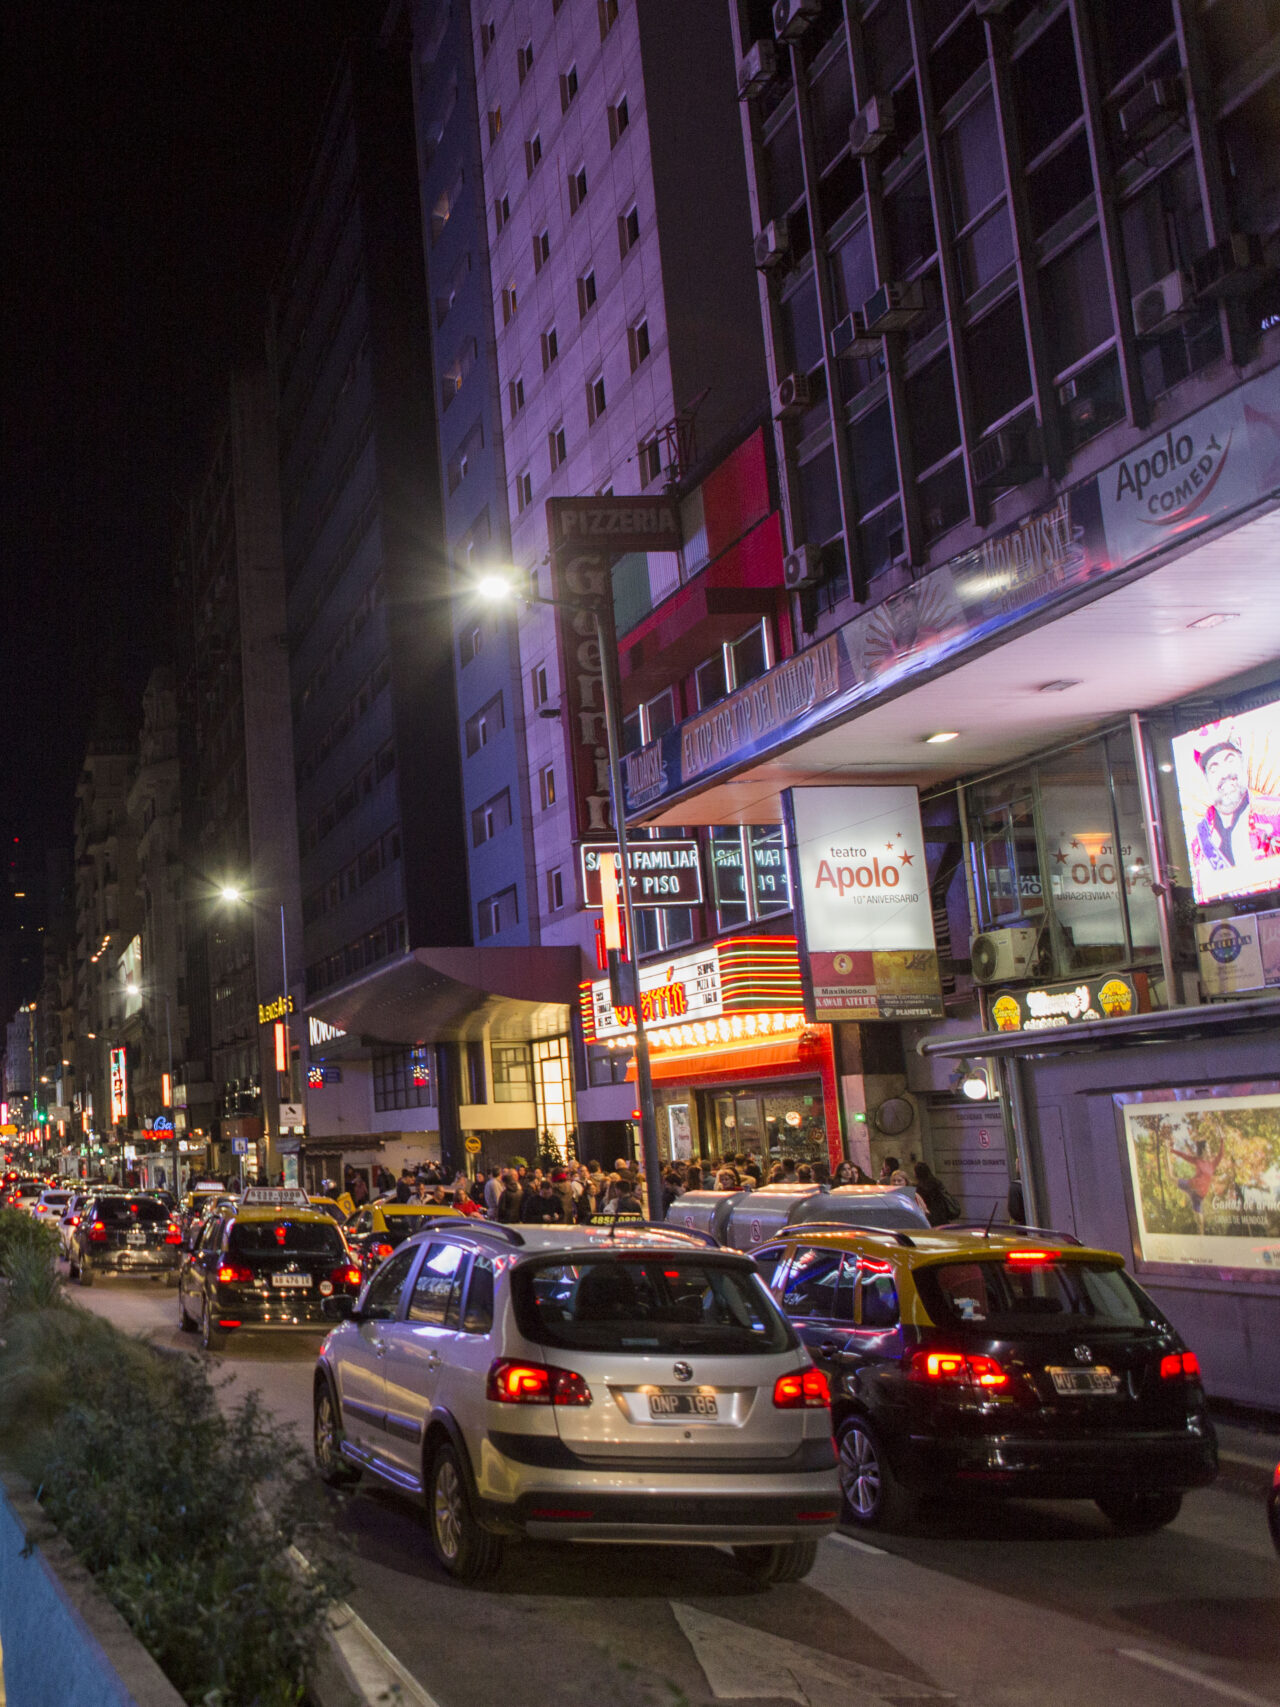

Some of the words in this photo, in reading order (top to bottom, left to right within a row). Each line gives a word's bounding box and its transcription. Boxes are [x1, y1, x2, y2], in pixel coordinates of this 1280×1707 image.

[1117, 431, 1194, 501] Apolo
[1147, 433, 1222, 514] COMEDY
[561, 508, 677, 535] PIZZERIA
[635, 850, 699, 870] FAMILIAR
[830, 847, 867, 858] teatro
[642, 875, 680, 895] PISO
[815, 857, 900, 896] Apolo
[867, 893, 919, 904] ANIVERSARIO
[821, 987, 868, 996] Maxikiosco
[686, 1395, 718, 1414] 186
